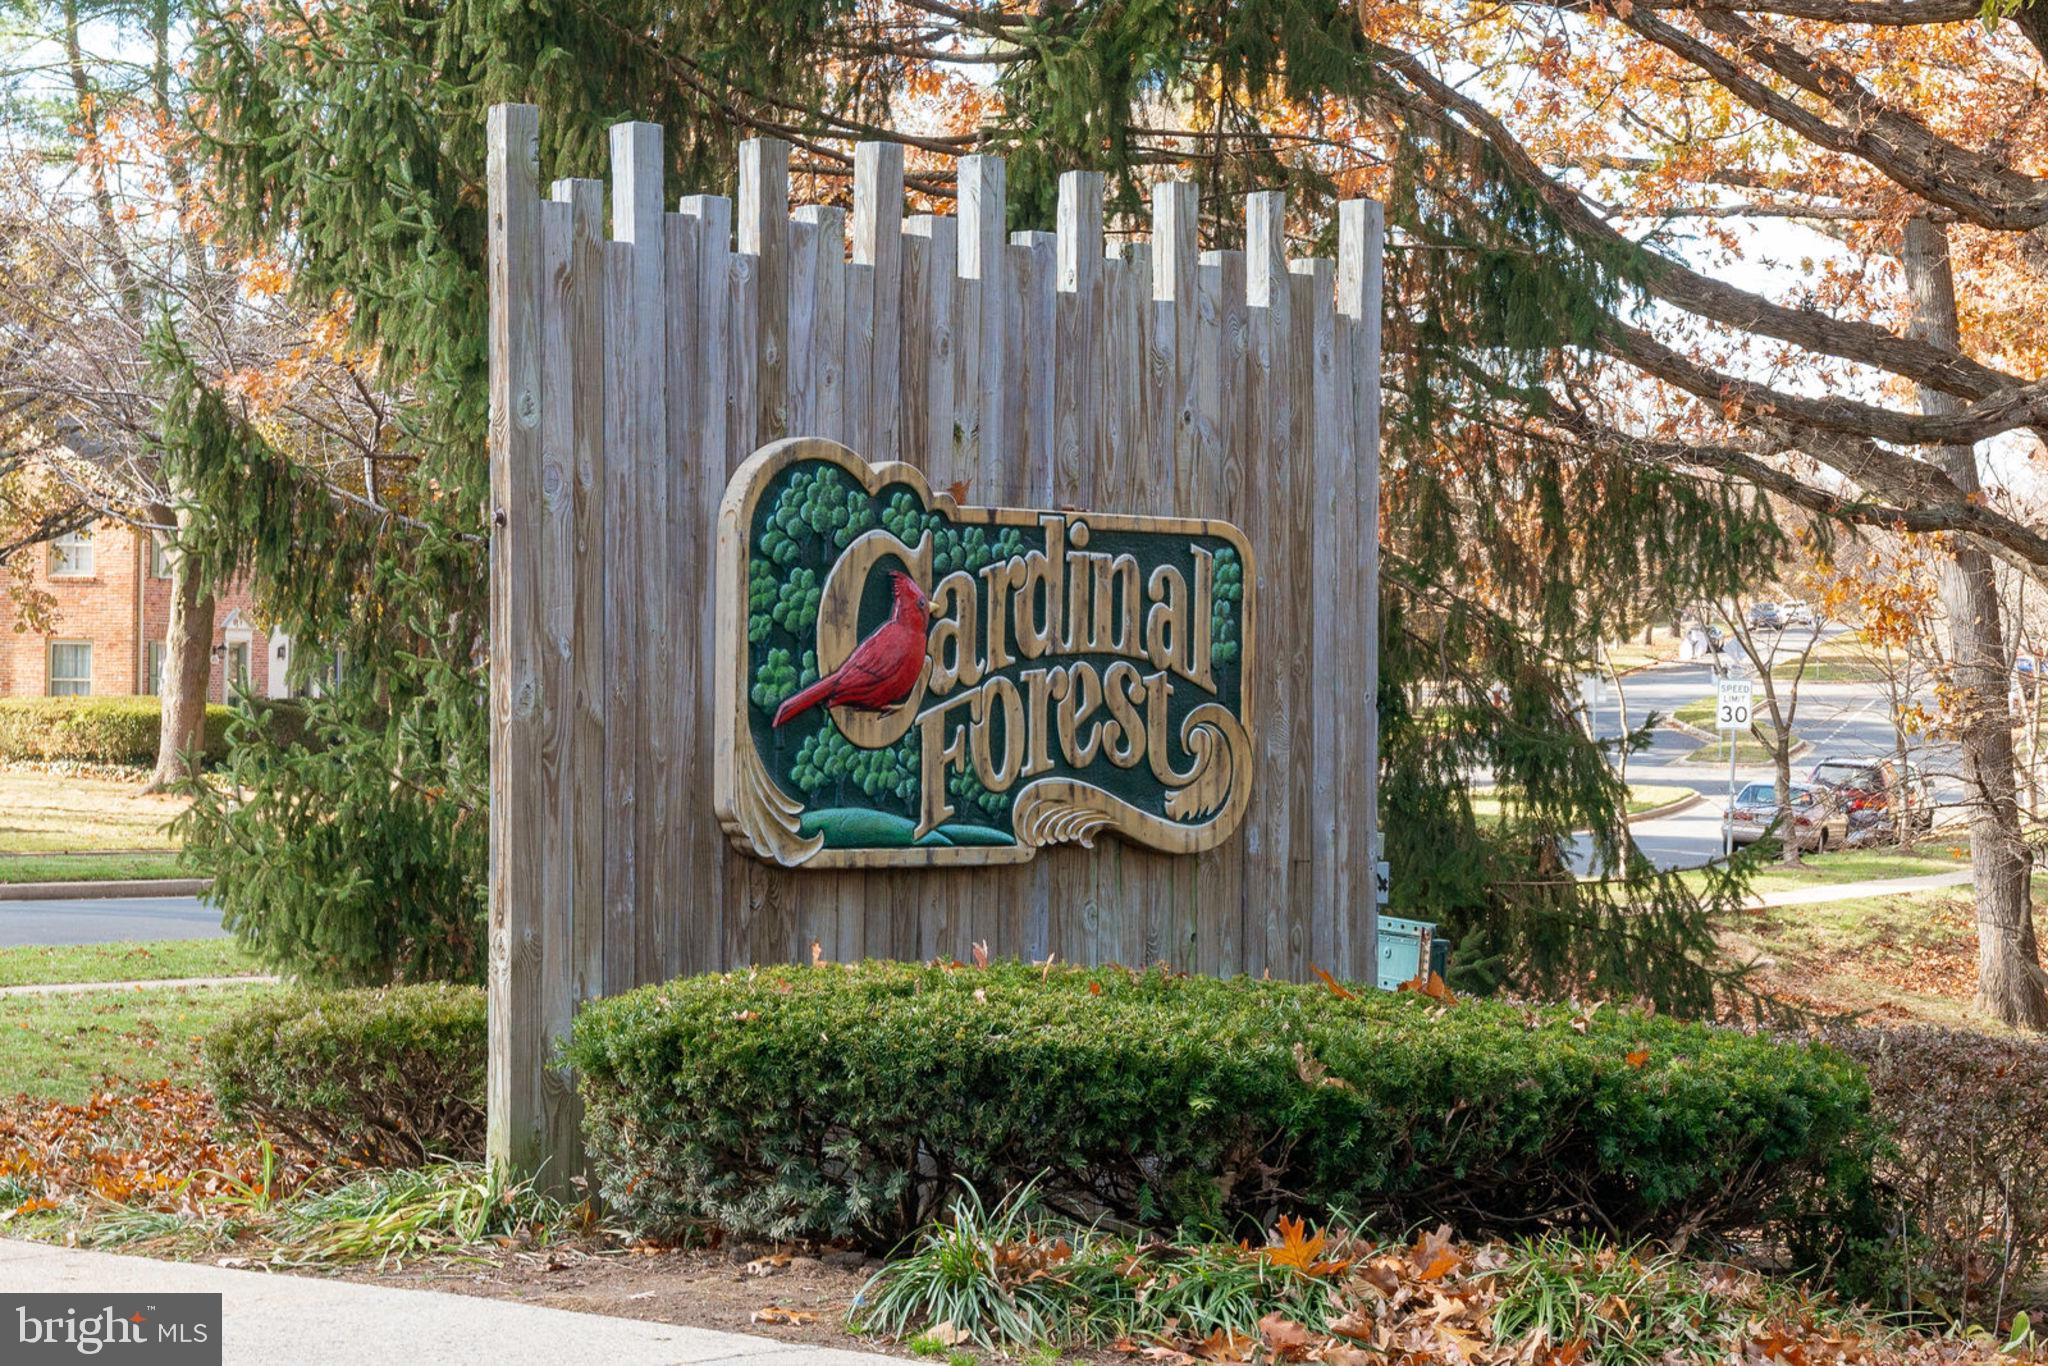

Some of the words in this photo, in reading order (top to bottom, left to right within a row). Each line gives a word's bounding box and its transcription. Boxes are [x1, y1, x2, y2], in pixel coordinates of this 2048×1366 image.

[817, 515, 1217, 748] Cardinal
[1721, 685, 1750, 693] SPEED
[1723, 695, 1745, 703] LIMIT
[1721, 705, 1748, 723] 30
[915, 662, 1214, 839] Forest
